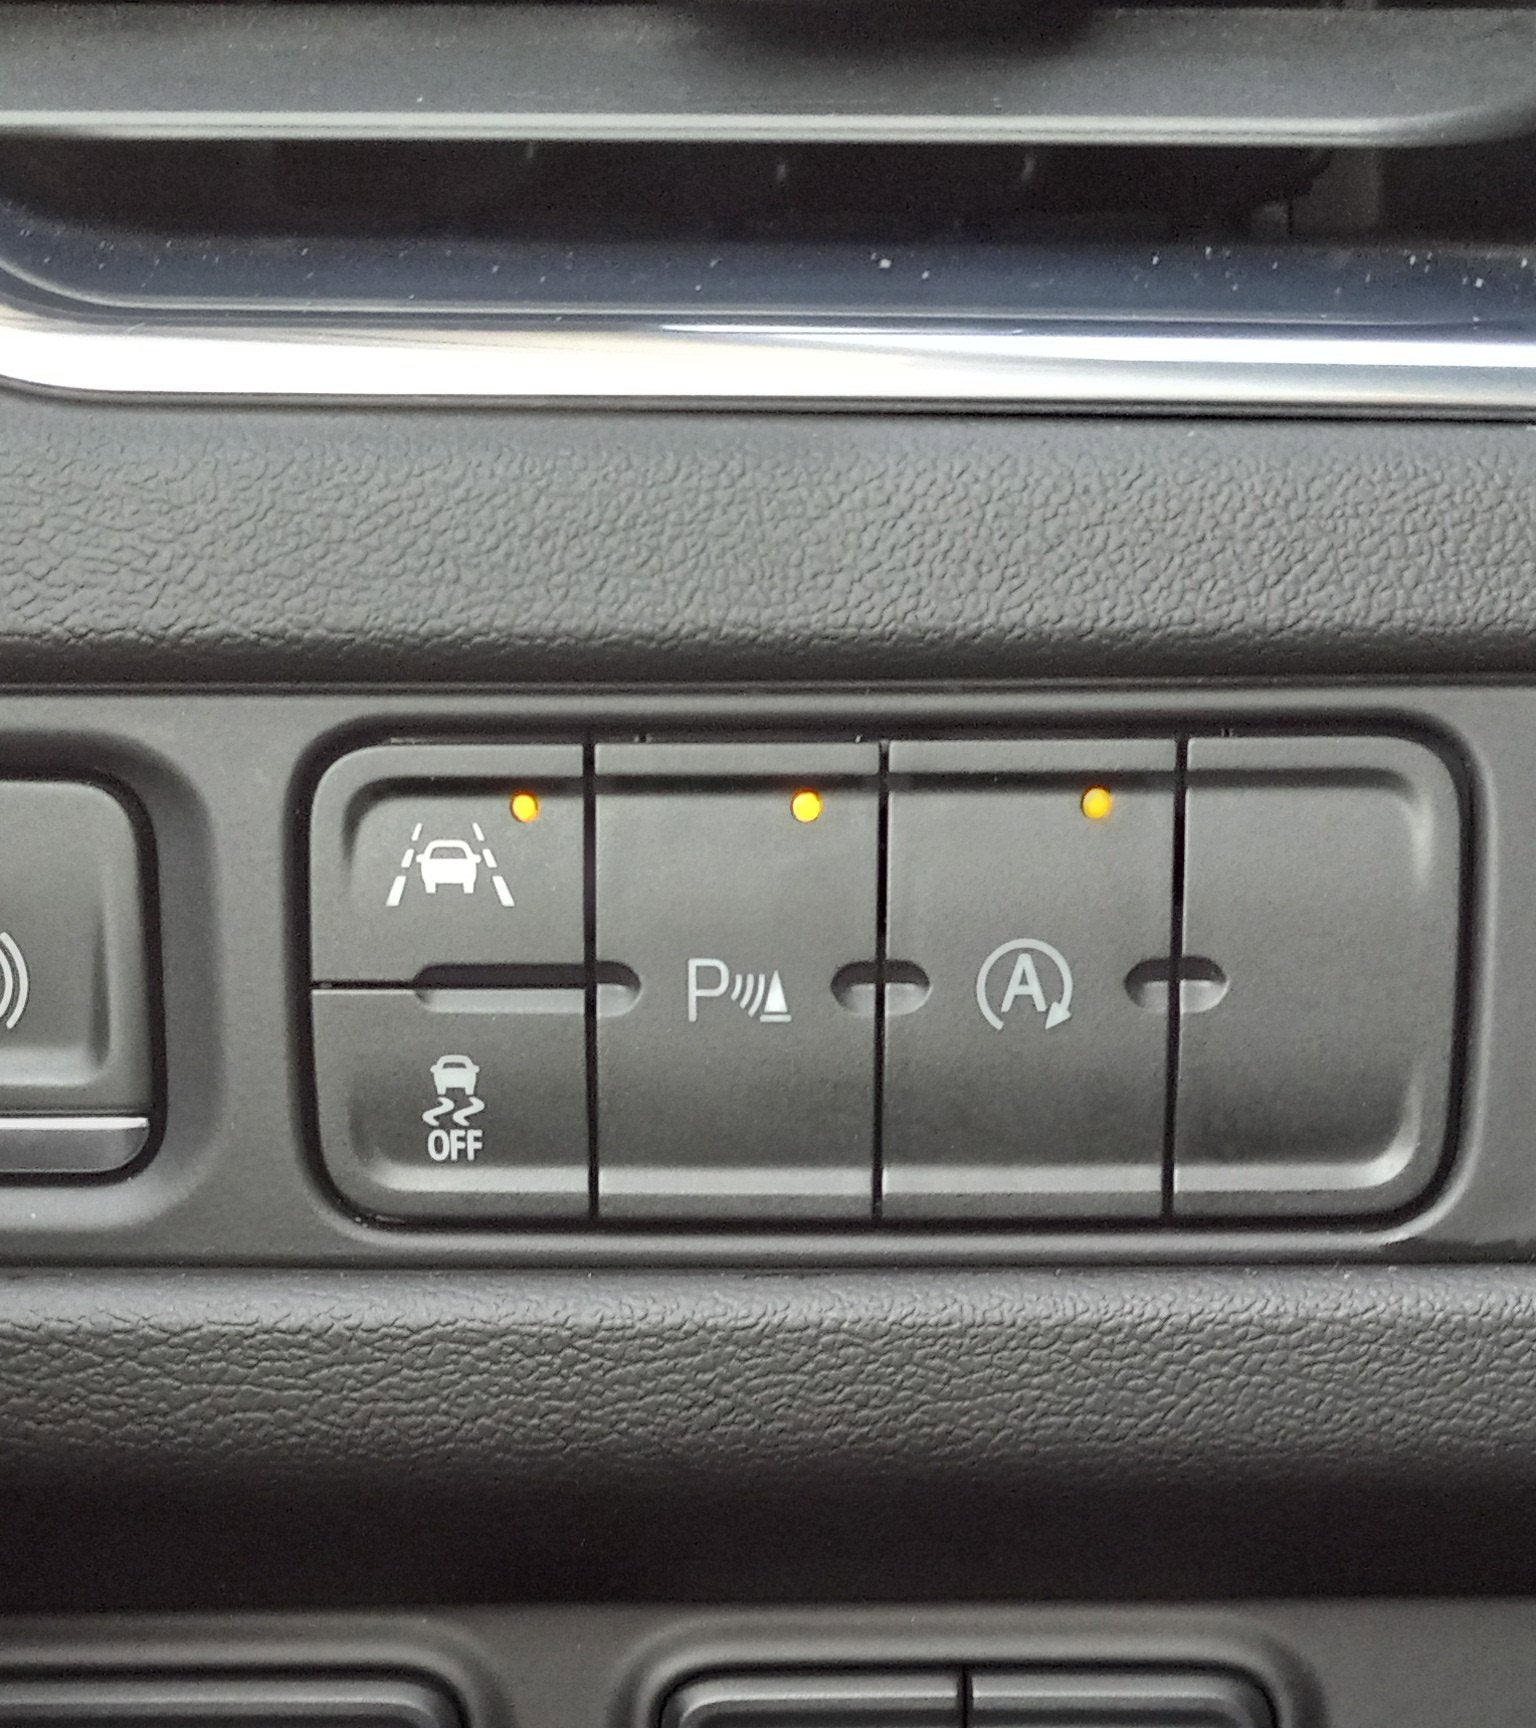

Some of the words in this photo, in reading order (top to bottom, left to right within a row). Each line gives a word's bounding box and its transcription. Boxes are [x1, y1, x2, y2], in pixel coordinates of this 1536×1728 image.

[687, 957, 729, 1022] P
[1001, 952, 1046, 1014] A
[427, 1130, 483, 1161] OFF
